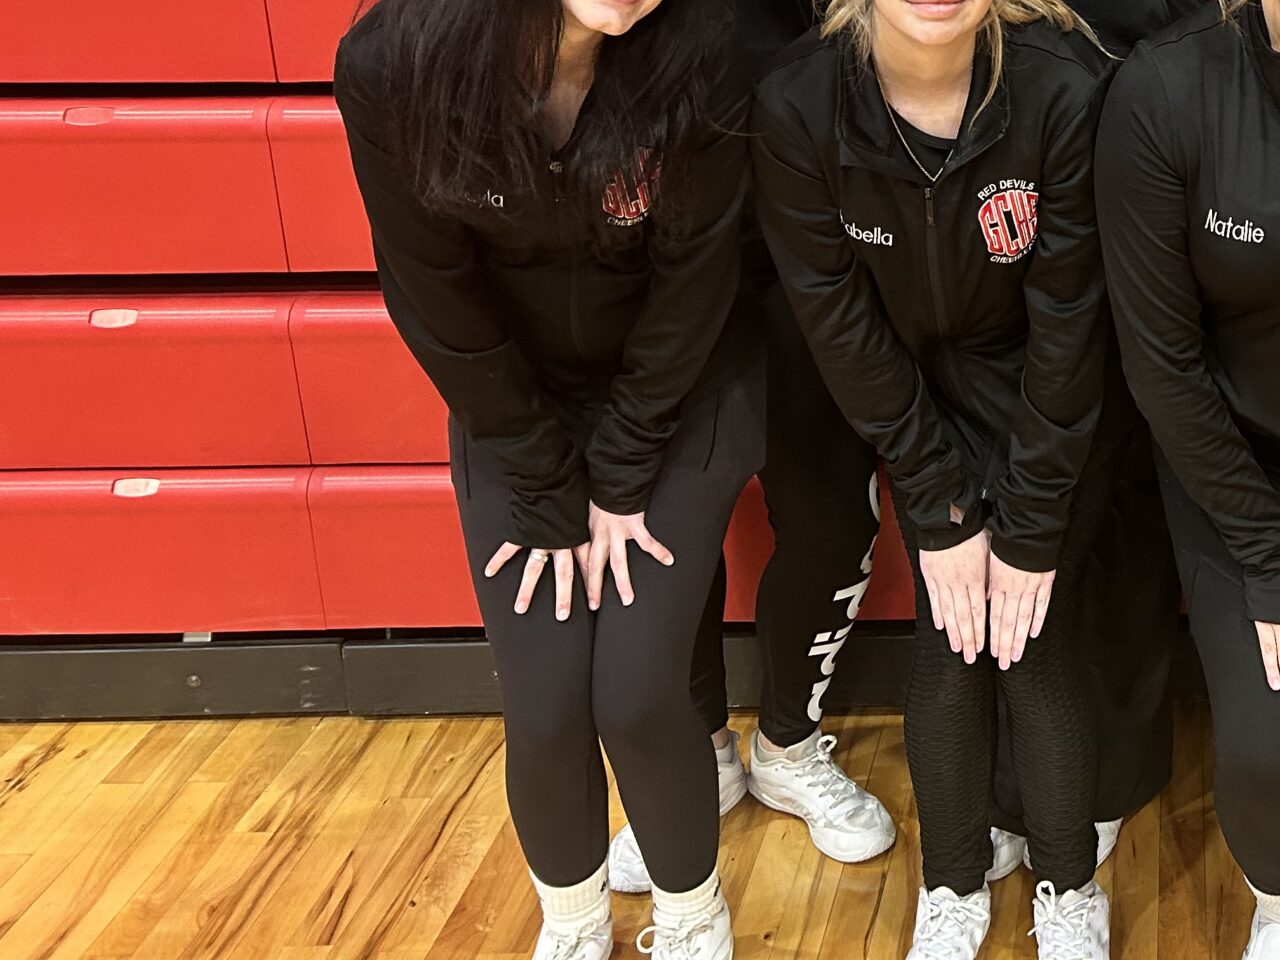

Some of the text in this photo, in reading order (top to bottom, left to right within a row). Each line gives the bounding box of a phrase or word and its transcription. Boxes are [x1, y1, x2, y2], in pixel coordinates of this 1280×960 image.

[977, 179, 1035, 200] RED DEVILS
[1204, 208, 1265, 244] Natalie
